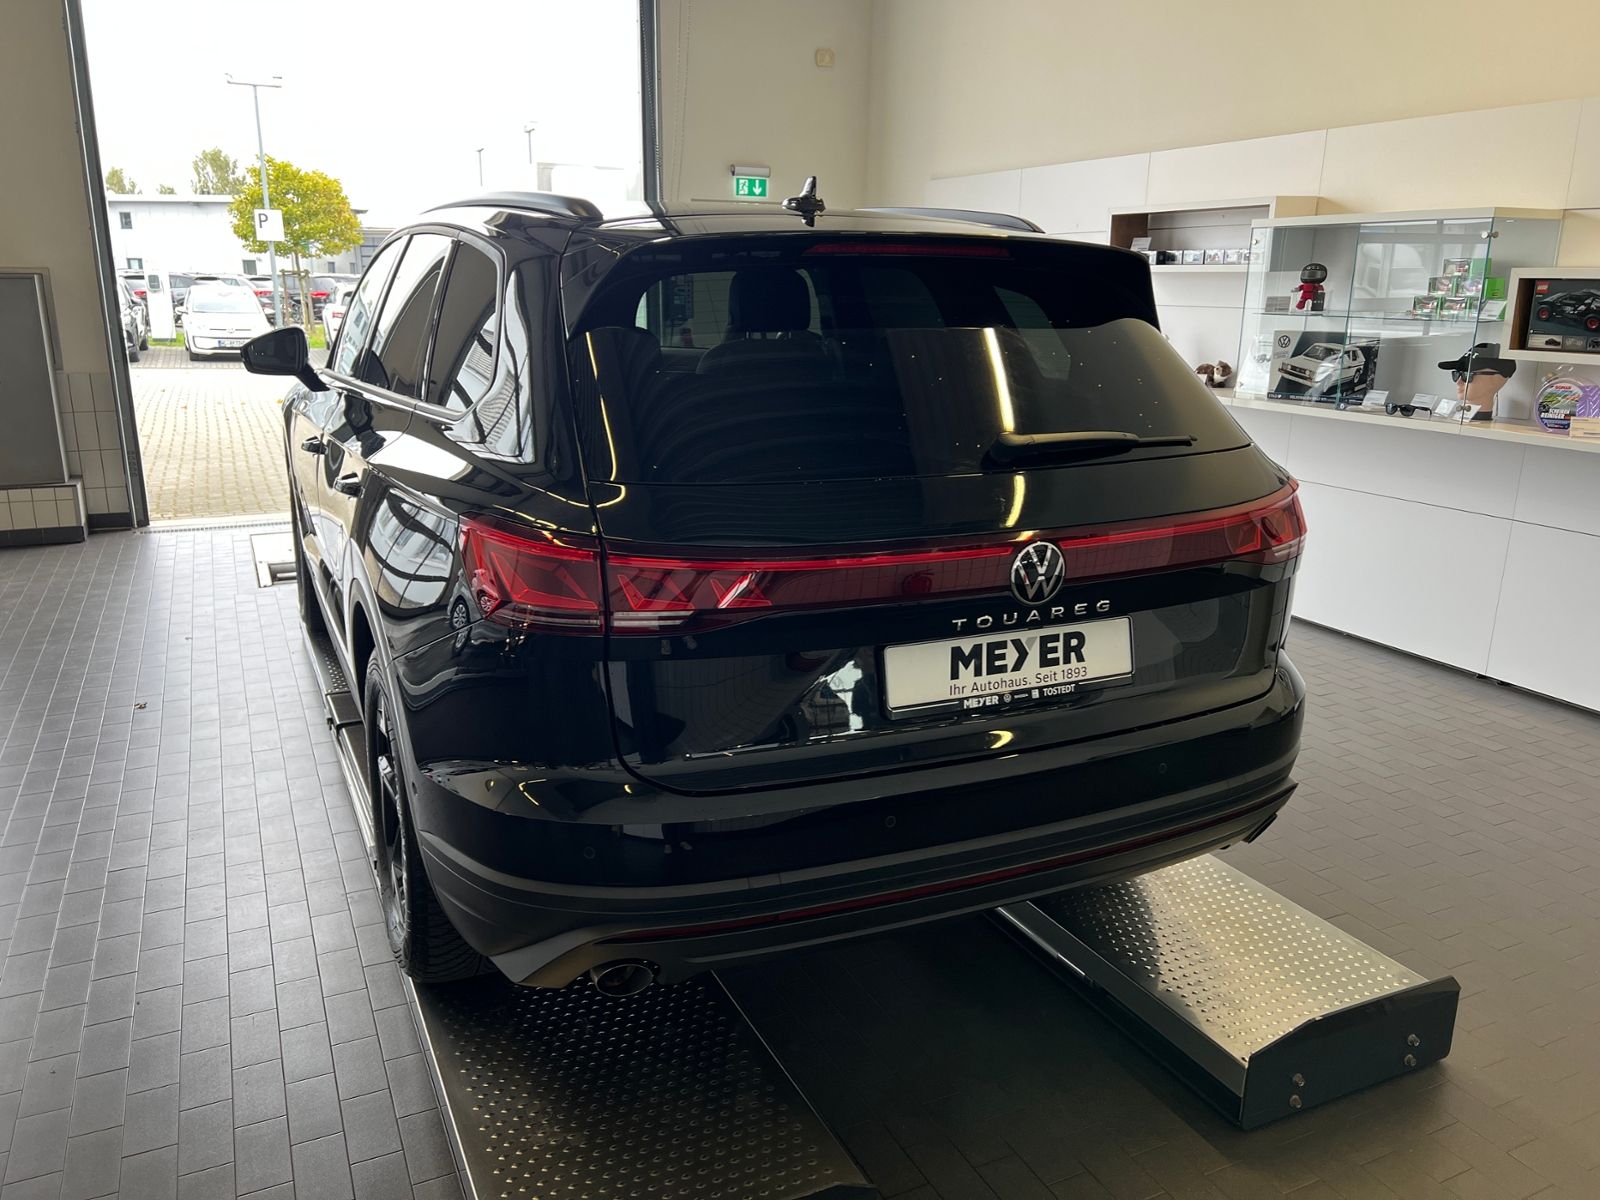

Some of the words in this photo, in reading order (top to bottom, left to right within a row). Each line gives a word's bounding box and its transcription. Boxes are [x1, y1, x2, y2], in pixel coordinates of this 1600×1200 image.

[258, 213, 268, 228] P
[952, 600, 1110, 631] TOUAREG
[950, 631, 1086, 680] MEYER
[949, 683, 967, 697] Ihr
[970, 676, 1032, 694] Autohaus.
[1035, 671, 1058, 684] Seit
[1061, 667, 1087, 680] 1893
[964, 695, 999, 709] MEYER
[1043, 684, 1075, 696] TOSTEDT
